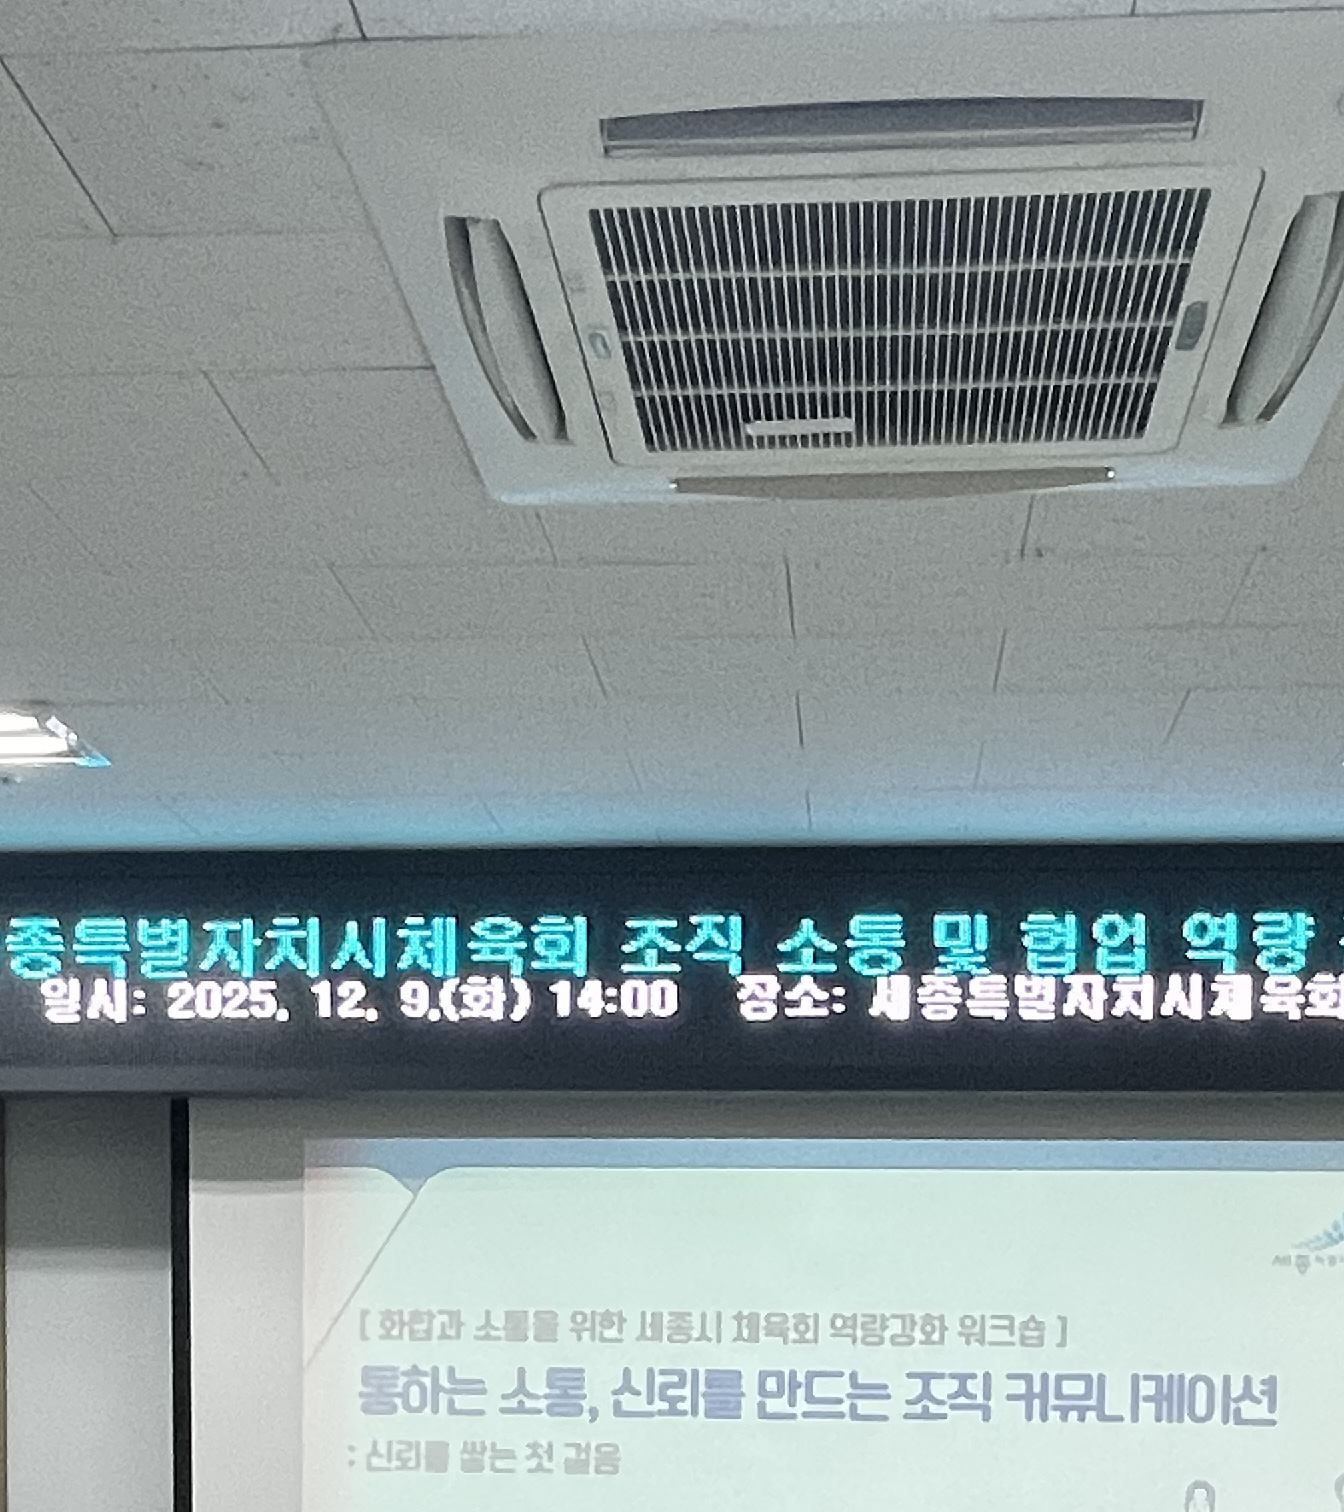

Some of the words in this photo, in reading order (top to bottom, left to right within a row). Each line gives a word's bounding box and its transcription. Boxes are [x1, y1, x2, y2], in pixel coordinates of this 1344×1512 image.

[620, 913, 744, 978] 조직
[776, 912, 905, 977] 소통
[932, 912, 990, 977] 및
[1018, 912, 1147, 977] 협업
[1181, 911, 1314, 976] 역량
[40, 976, 147, 1024] 일시:
[166, 979, 291, 1023] 2025.
[309, 979, 379, 1023] 12.
[399, 975, 533, 1023] 9.(화)
[548, 978, 680, 1019] 14:00
[735, 974, 847, 1022] 장소:
[377, 1308, 465, 1343] 화합과
[569, 1309, 628, 1344] 위한
[634, 1309, 723, 1344] 세종시
[731, 1310, 821, 1346] 체육회
[828, 1311, 950, 1348] 역량강화
[957, 1313, 1047, 1348] 워크숍
[358, 1363, 488, 1417] 통하는
[498, 1365, 600, 1424] 소통,
[610, 1366, 747, 1420] 신뢰를
[756, 1368, 893, 1422] 만드는
[902, 1370, 993, 1423] 조직
[1005, 1371, 1279, 1427] 커뮤니케이션
[365, 1439, 451, 1474] 신뢰를
[524, 1440, 555, 1474] 첫
[563, 1441, 622, 1476] 걸음
